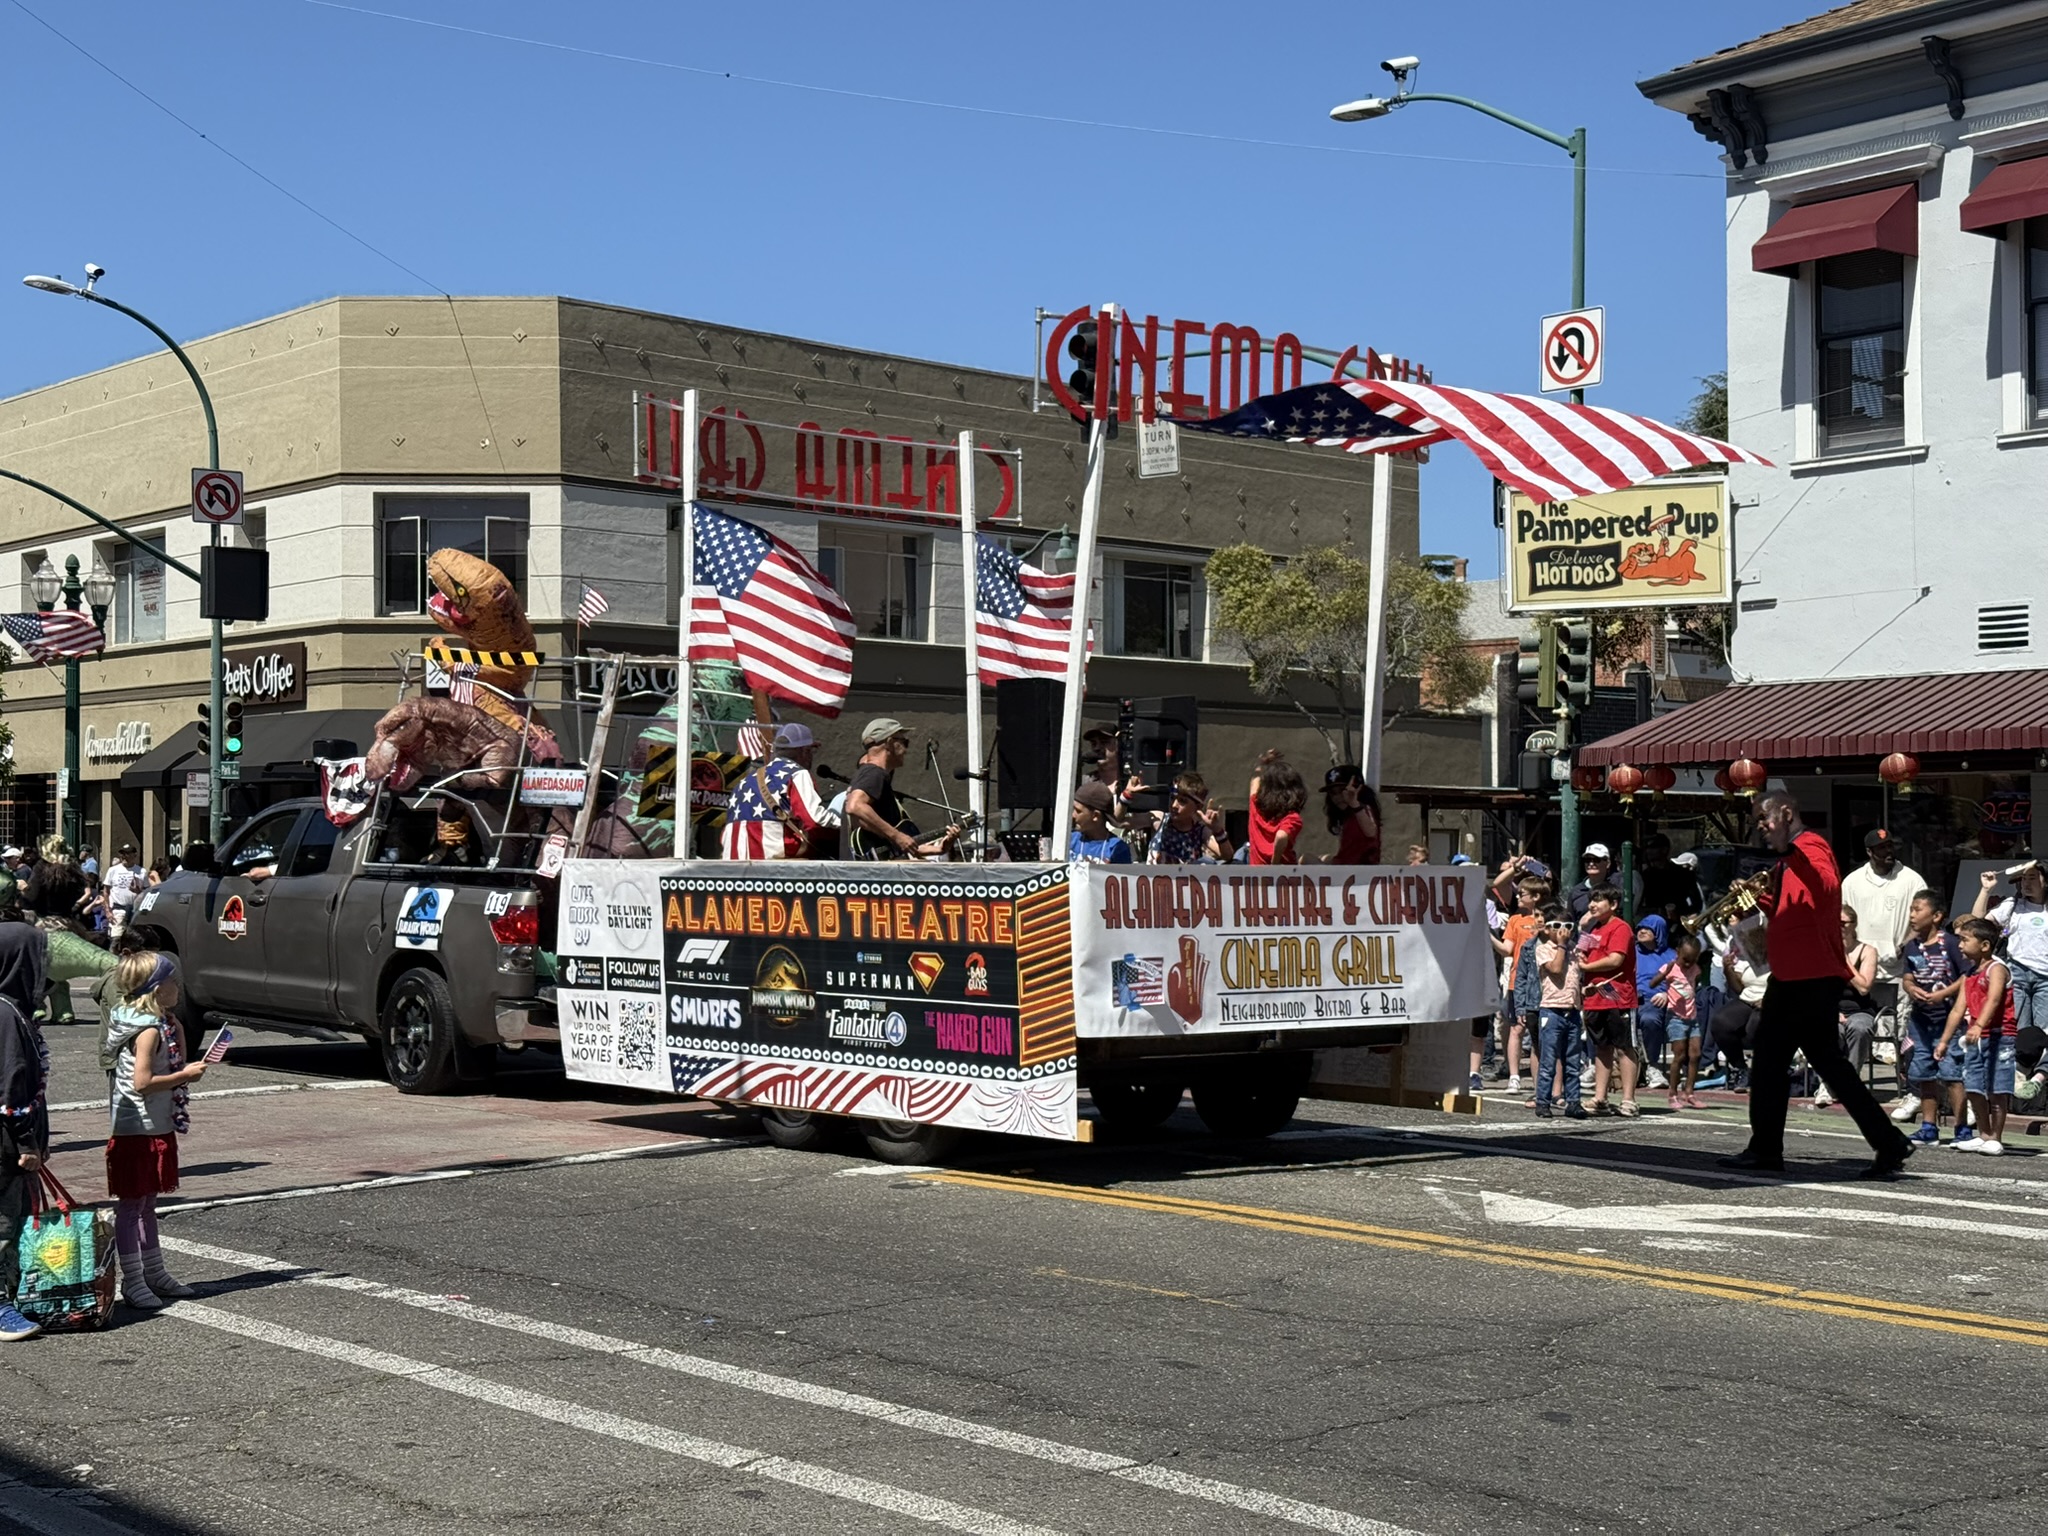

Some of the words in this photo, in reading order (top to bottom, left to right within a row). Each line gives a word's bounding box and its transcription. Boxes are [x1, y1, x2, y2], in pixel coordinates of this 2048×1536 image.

[1145, 430, 1172, 443] TURN
[1541, 500, 1569, 518] The
[1517, 505, 1654, 545] Pampered
[1667, 502, 1719, 539] Pup
[1549, 549, 1605, 566] Deluxe
[1536, 560, 1570, 587] HOT
[253, 653, 294, 698] Coffee
[84, 720, 152, 758] homeskillet
[1531, 737, 1556, 749] TROY
[522, 776, 585, 792] ALAMEDASAUR
[702, 790, 730, 807] PARK
[571, 885, 595, 904] LIVE
[1100, 875, 1223, 929] ALAMEDA
[1229, 874, 1333, 928] THEATRE
[1342, 874, 1361, 926] &
[1368, 873, 1470, 925] CINEPLEX
[486, 895, 509, 913] 119
[607, 904, 622, 916] THE
[623, 906, 652, 917] LIVING
[569, 906, 600, 925] MUSIC
[608, 916, 653, 930] DAYLIGHT
[665, 895, 810, 936] ALAMEDA
[847, 898, 1014, 944] THEATRE
[420, 921, 439, 936] WORLD
[574, 928, 591, 946] BY
[677, 938, 730, 965] F1
[608, 960, 647, 976] FOLLOW
[649, 963, 661, 978] US
[1221, 935, 1322, 990] CINEMA
[1332, 934, 1403, 987] GRILL
[677, 970, 695, 979] THE
[698, 971, 730, 982] MOVIE
[826, 970, 915, 991] SUPERMAN
[970, 966, 987, 979] BAD
[611, 977, 623, 987] ON
[624, 978, 655, 989] INSTAGRAM
[968, 978, 988, 992] GUYS
[752, 989, 783, 1008] JURASSIC
[784, 993, 816, 1011] WORLD
[1221, 997, 1306, 1022] NEIGHBORHOOD
[1314, 993, 1352, 1018] BISTRO
[1360, 992, 1371, 1015] &
[1380, 991, 1407, 1015] BAR
[571, 1000, 609, 1021] WIN
[670, 994, 742, 1029] SMURFS
[573, 1021, 583, 1030] UP
[585, 1022, 594, 1031] TO
[596, 1023, 611, 1033] ONE
[829, 1009, 885, 1038] Fantastic
[571, 1033, 598, 1046] YEAR
[601, 1034, 614, 1047] OF
[936, 1012, 979, 1053] NAKED
[981, 1015, 1013, 1056] GUN
[865, 1041, 887, 1049] STEPS
[571, 1047, 612, 1063] MOVIES
